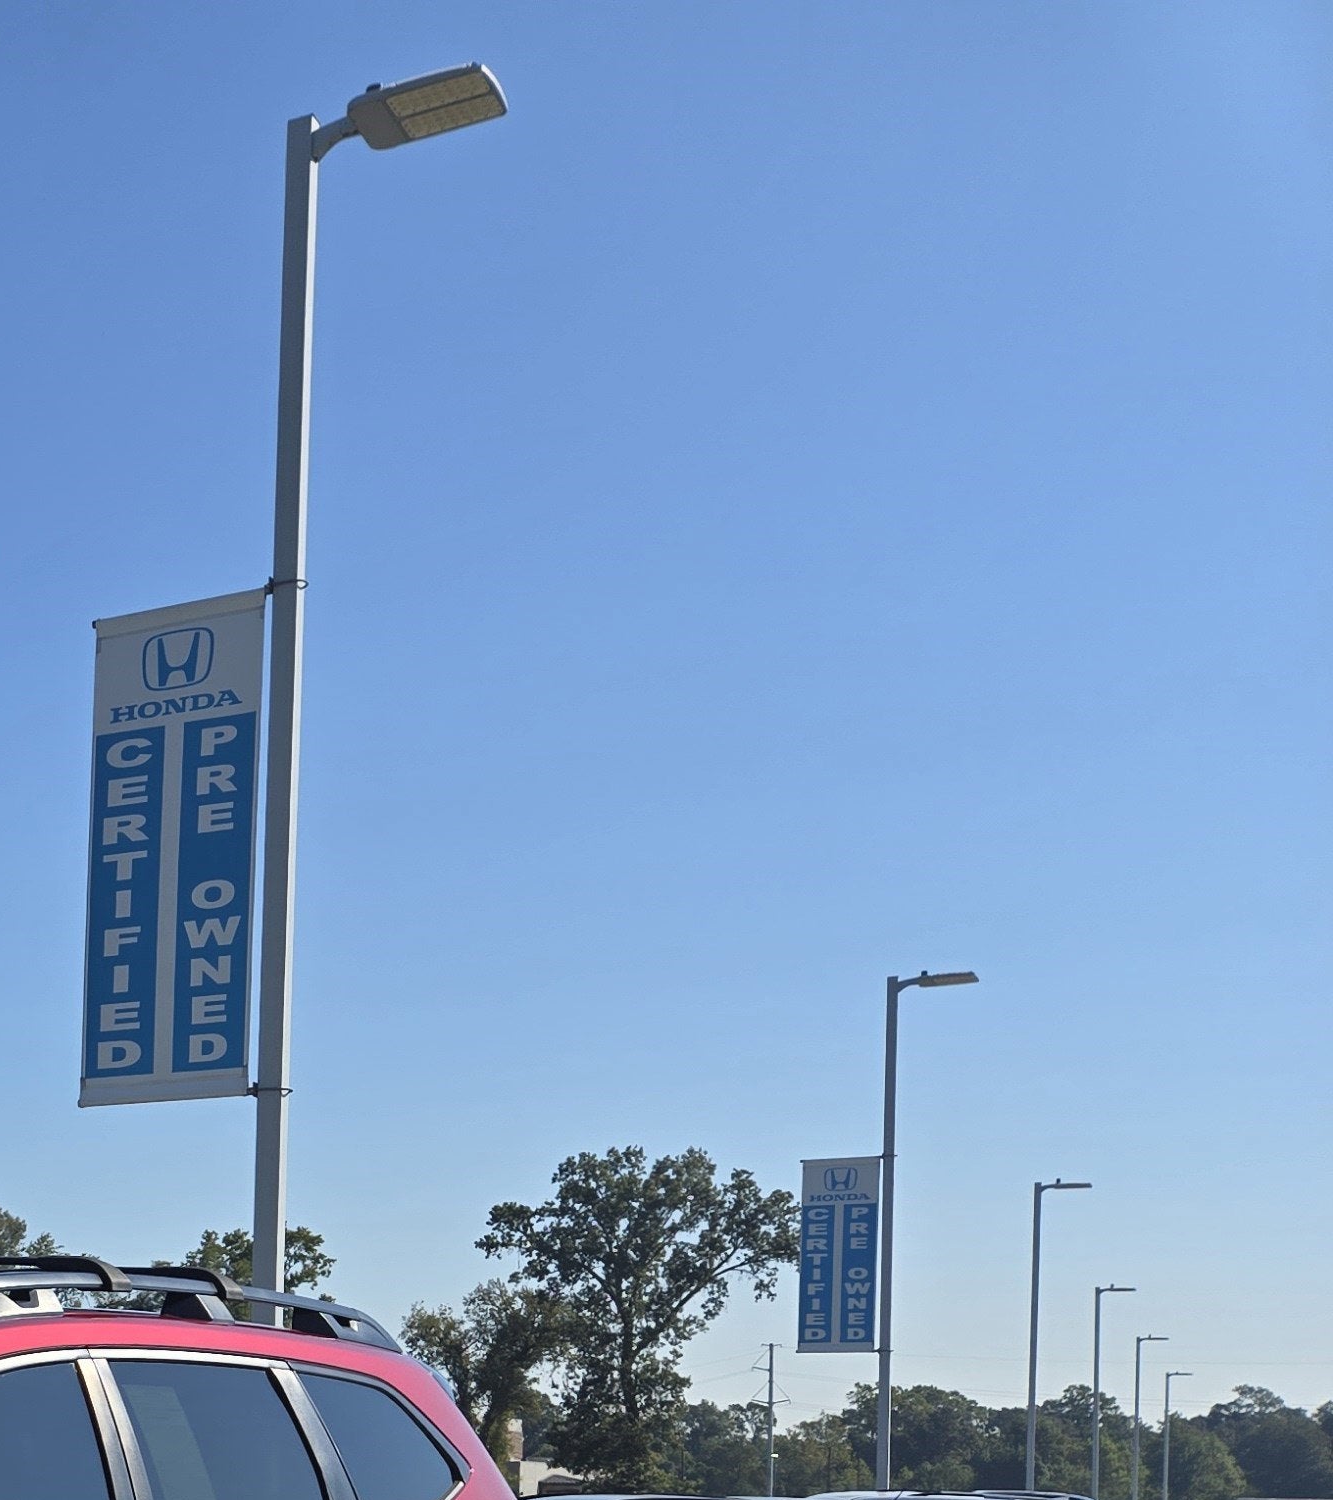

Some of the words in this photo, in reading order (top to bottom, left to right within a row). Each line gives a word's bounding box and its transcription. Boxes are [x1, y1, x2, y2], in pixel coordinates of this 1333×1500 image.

[109, 689, 243, 725] HONDA
[195, 725, 239, 834] PRE
[96, 737, 153, 1070] CERTIFIED
[183, 878, 242, 1064] OWNED
[809, 1193, 871, 1202] HONDA
[849, 1207, 869, 1250] PRE
[805, 1208, 829, 1340] CERTIFIED
[844, 1267, 871, 1340] OWNED
